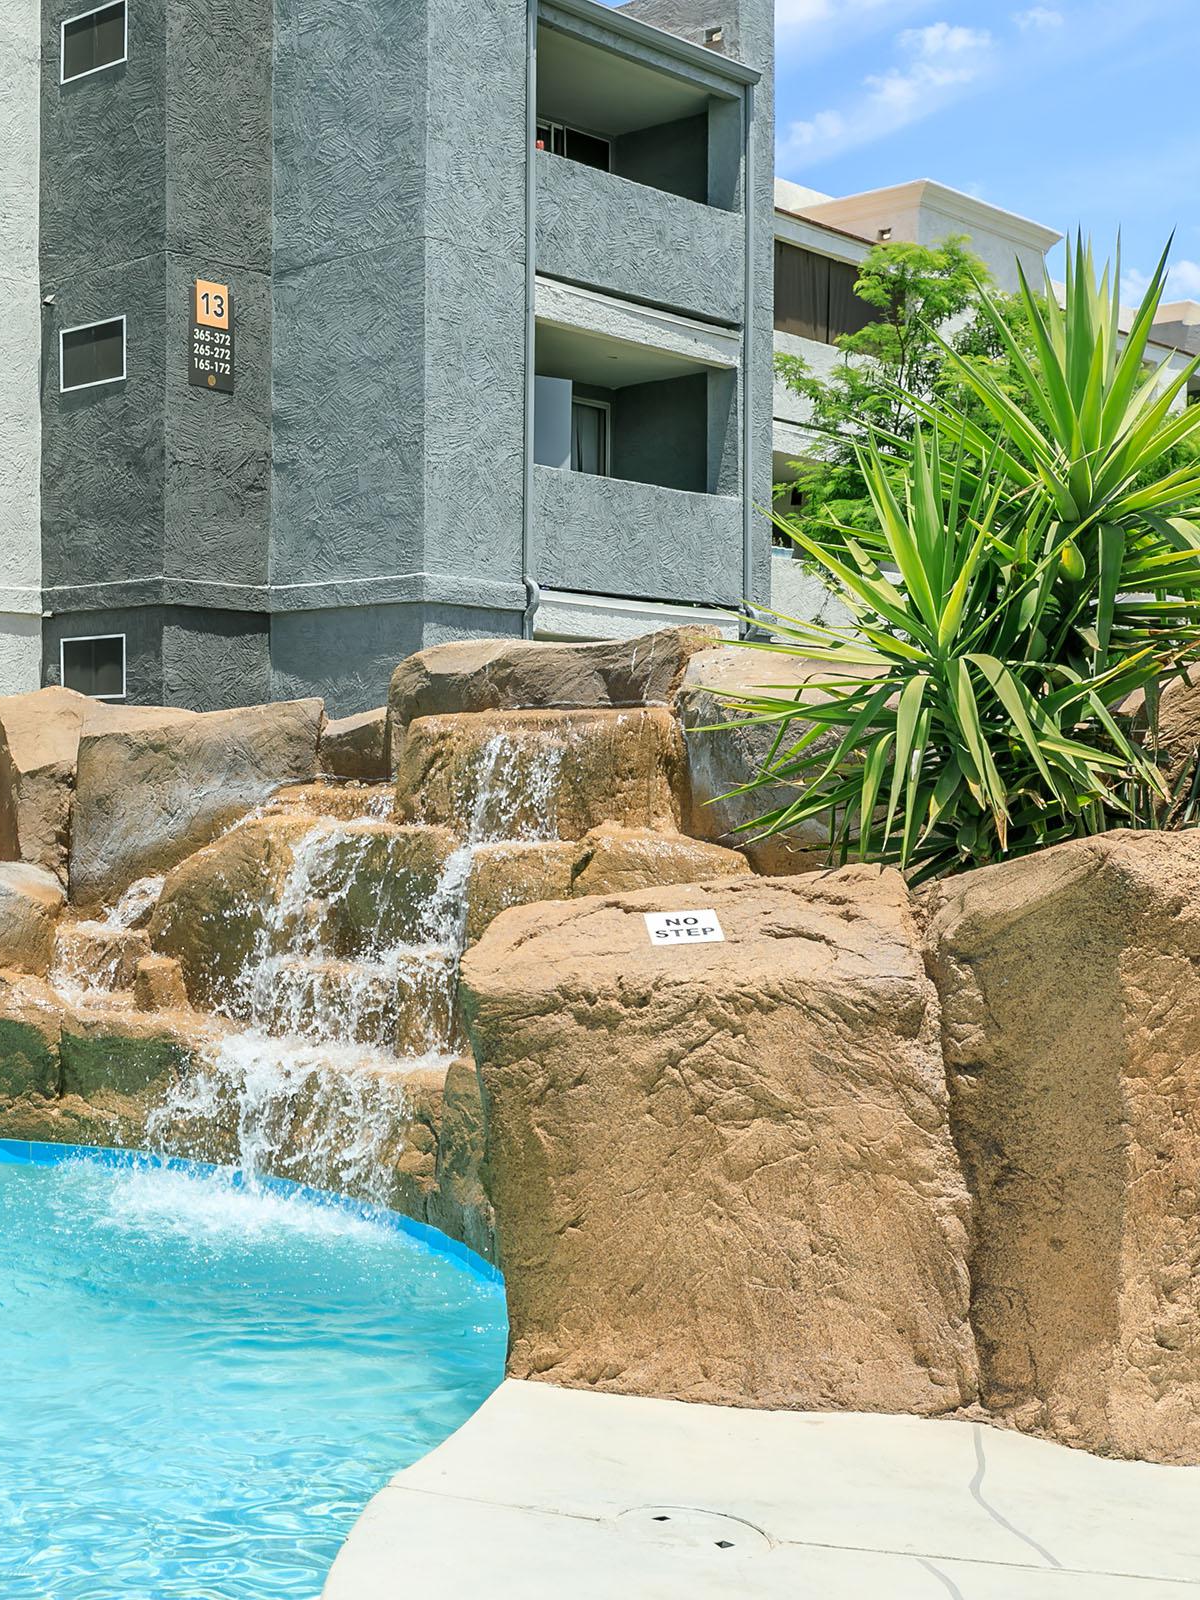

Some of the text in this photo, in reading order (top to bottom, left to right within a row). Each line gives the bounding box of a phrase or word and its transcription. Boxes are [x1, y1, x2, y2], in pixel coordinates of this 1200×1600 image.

[201, 292, 225, 318] 13
[193, 328, 231, 346] 365-372
[193, 343, 231, 360] 265-272
[194, 358, 231, 375] 165-172
[665, 917, 698, 926] NO
[655, 927, 715, 938] STEP
